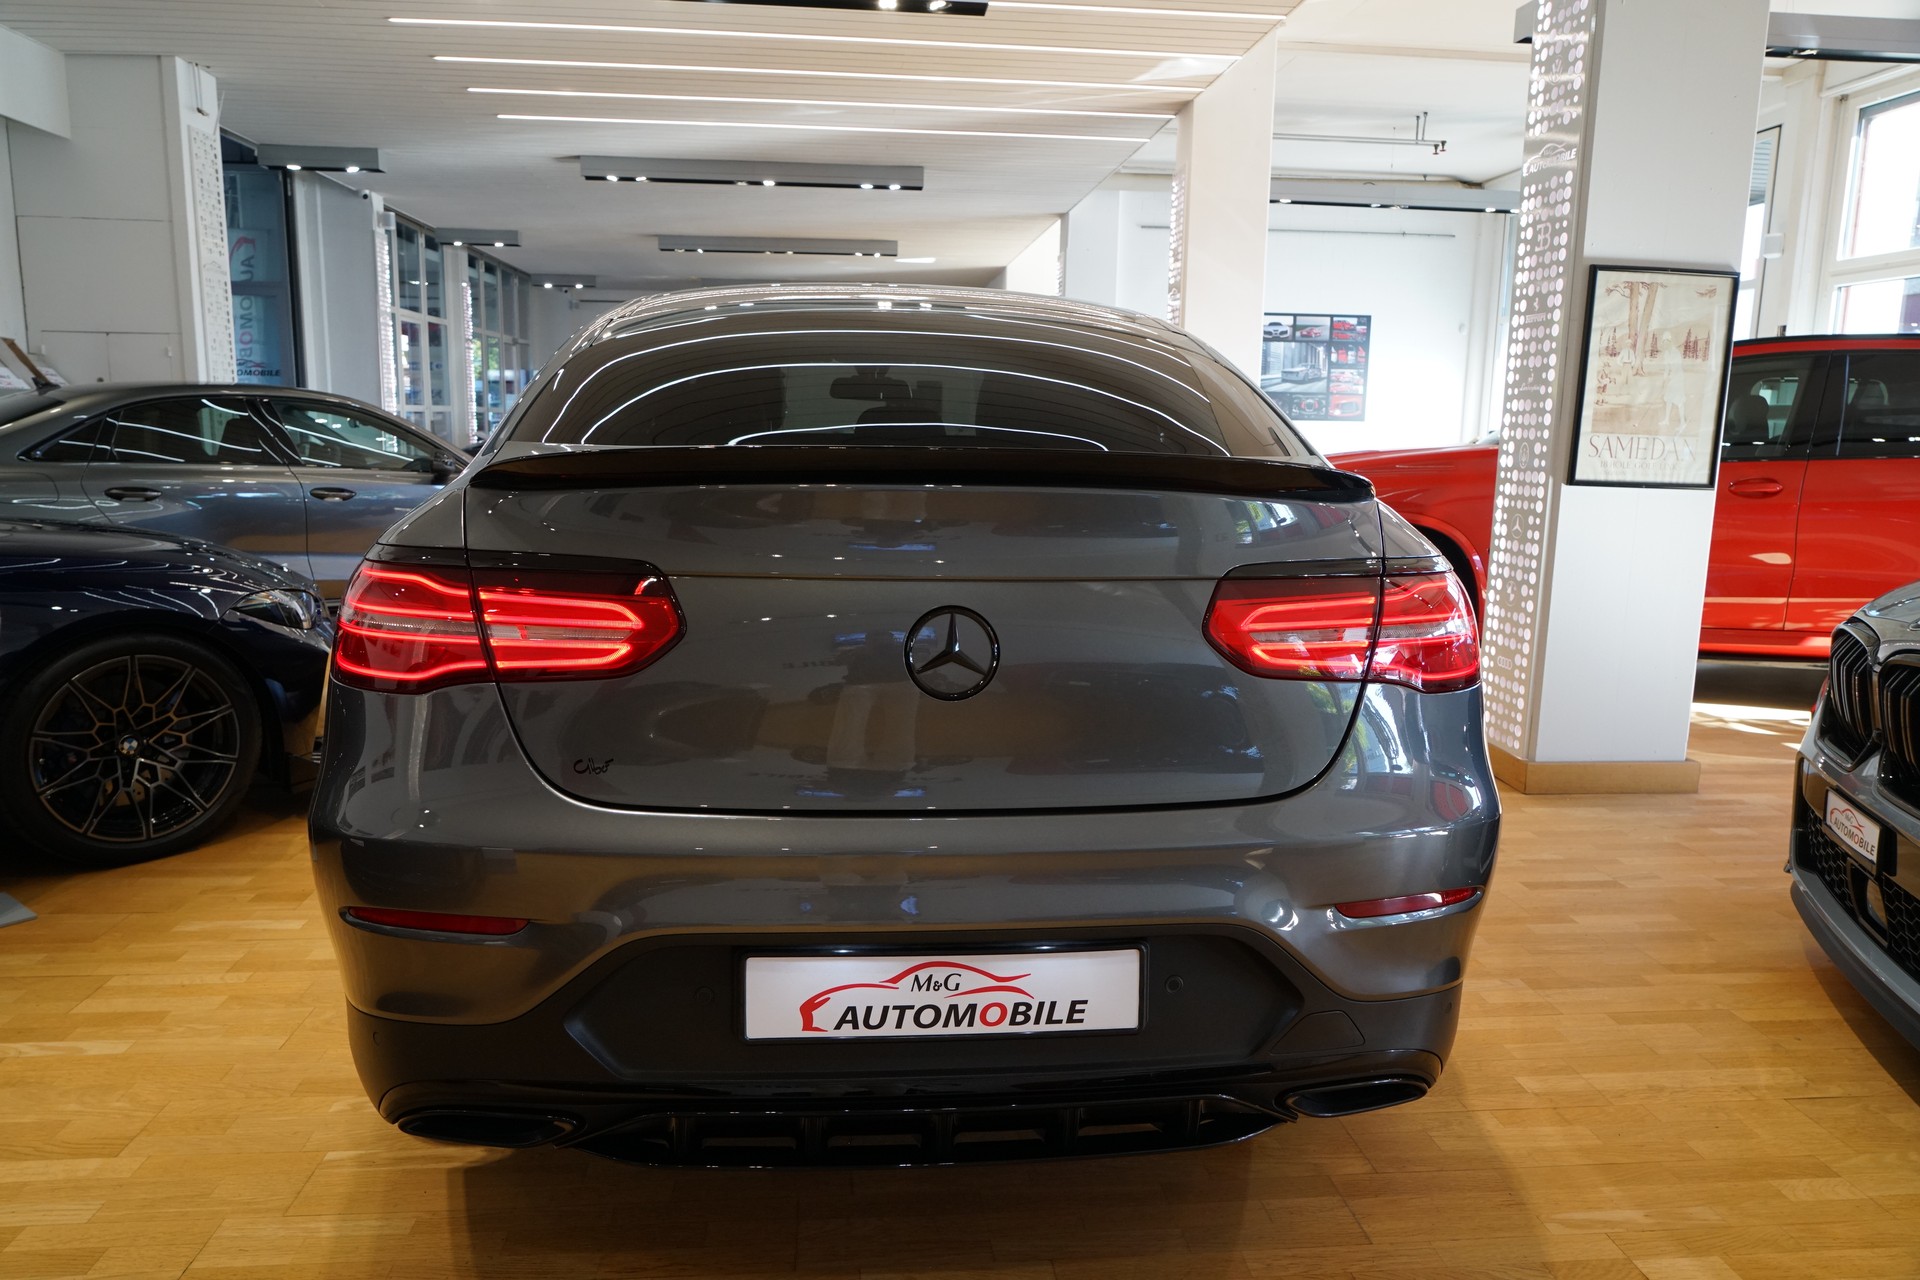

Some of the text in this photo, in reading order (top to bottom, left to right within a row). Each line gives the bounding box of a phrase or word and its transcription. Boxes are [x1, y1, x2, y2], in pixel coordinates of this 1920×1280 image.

[1588, 434, 1698, 462] SAMEDAN
[1834, 817, 1876, 856] AUTOMOBILE
[911, 973, 962, 992] M&G
[833, 1000, 1089, 1030] AUTOMOBILE
